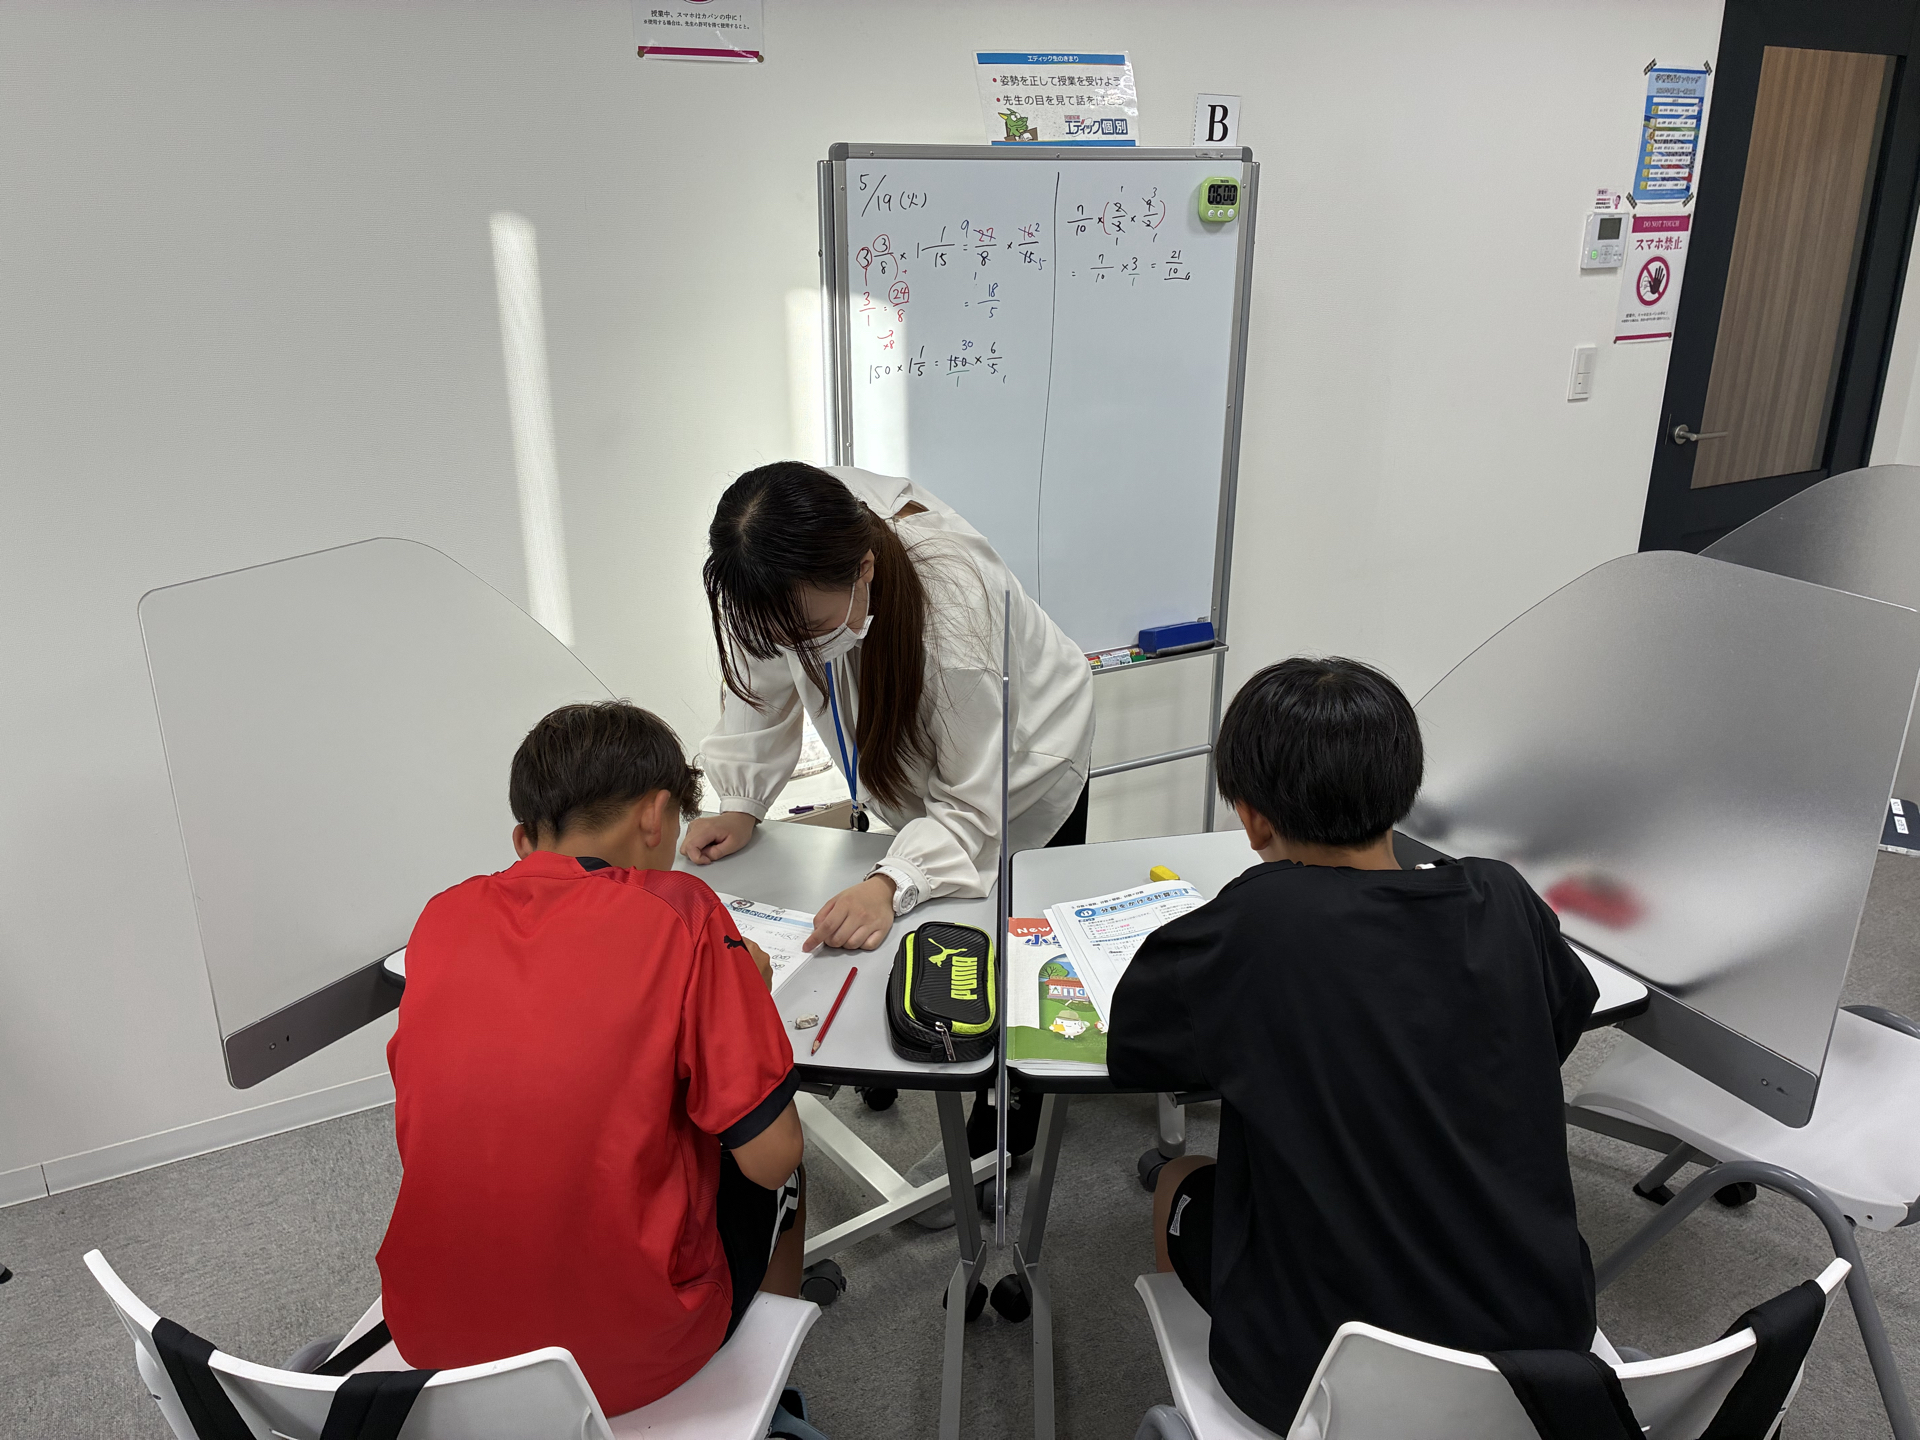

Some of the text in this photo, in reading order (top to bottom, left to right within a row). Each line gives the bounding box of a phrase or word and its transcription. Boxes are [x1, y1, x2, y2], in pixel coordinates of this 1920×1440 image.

[1027, 54, 1080, 63] エディック生のきまり
[1206, 104, 1229, 142] B
[1075, 224, 1086, 236] 10
[1651, 220, 1662, 228] NOT
[1634, 236, 1683, 251] スマホ禁止
[933, 253, 948, 268] 15
[1131, 256, 1139, 272] 3
[1170, 249, 1182, 260] 21
[987, 282, 999, 298] 18
[869, 365, 891, 384] 150
[960, 339, 974, 351] 30
[989, 342, 997, 354] 6
[1016, 926, 1051, 934] New
[951, 955, 978, 1001] PUMA
